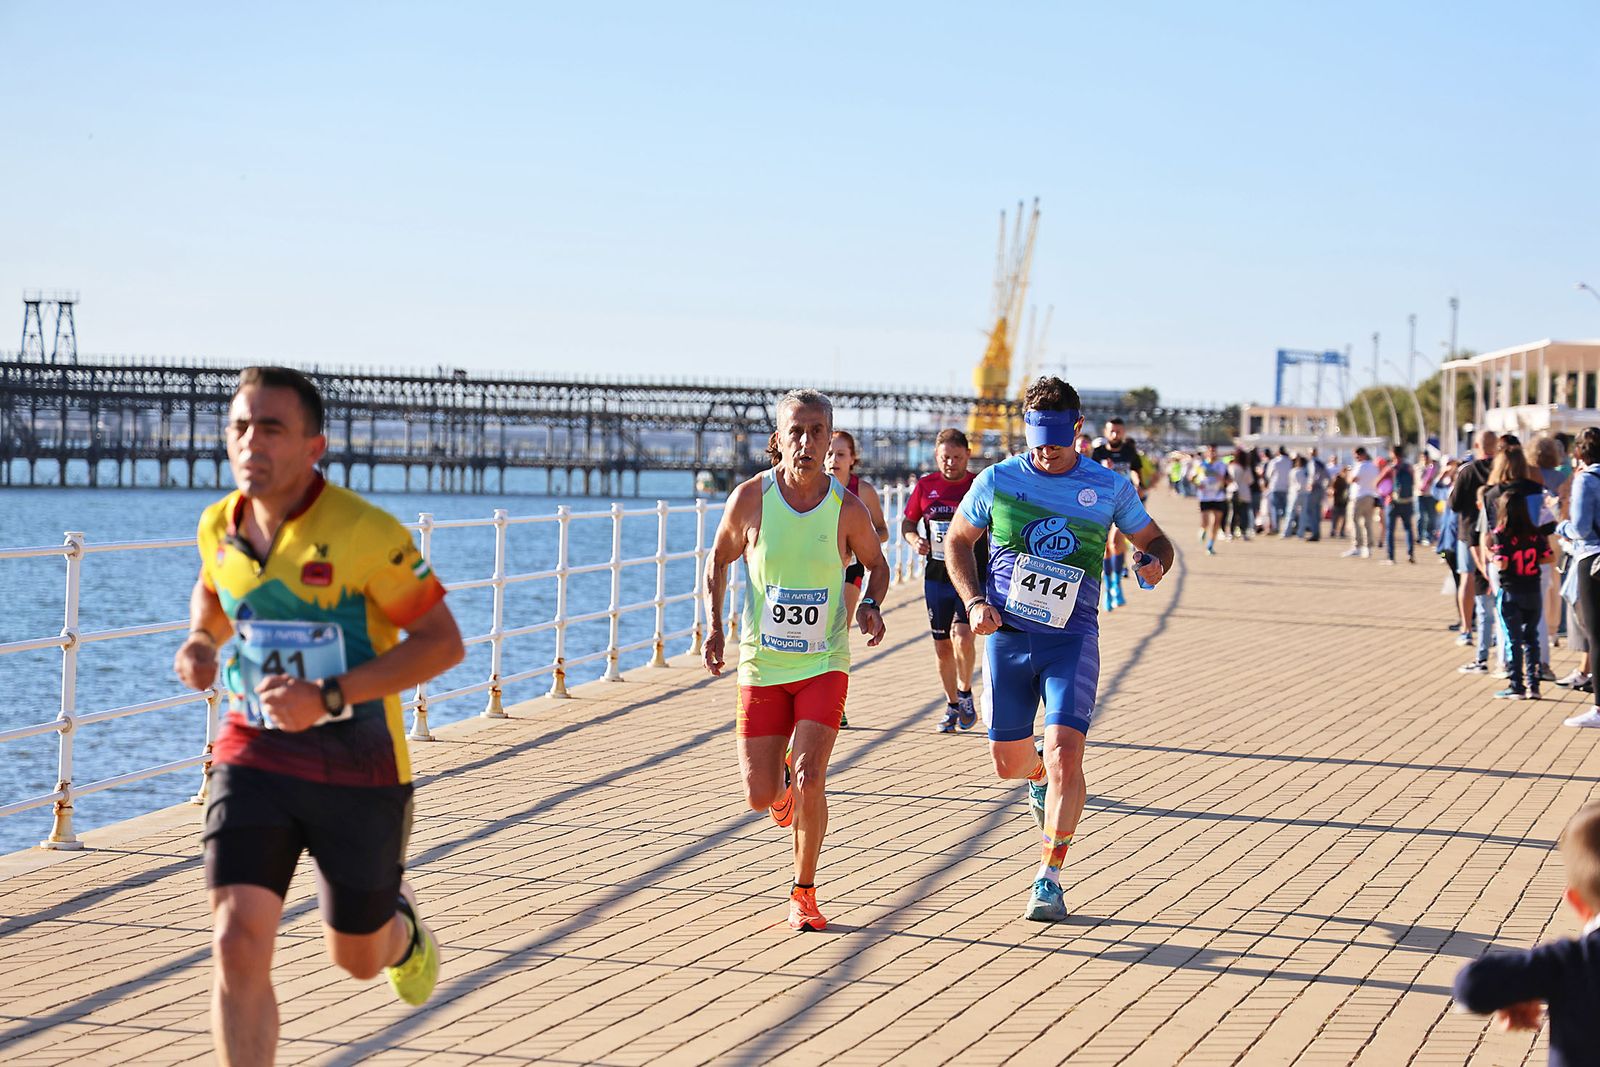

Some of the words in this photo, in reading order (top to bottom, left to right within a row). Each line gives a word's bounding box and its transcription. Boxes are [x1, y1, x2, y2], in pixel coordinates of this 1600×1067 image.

[1047, 535, 1071, 550] JD
[1513, 548, 1538, 576] 12
[1021, 573, 1069, 601] 414
[772, 604, 819, 626] 930
[261, 649, 305, 681] 41
